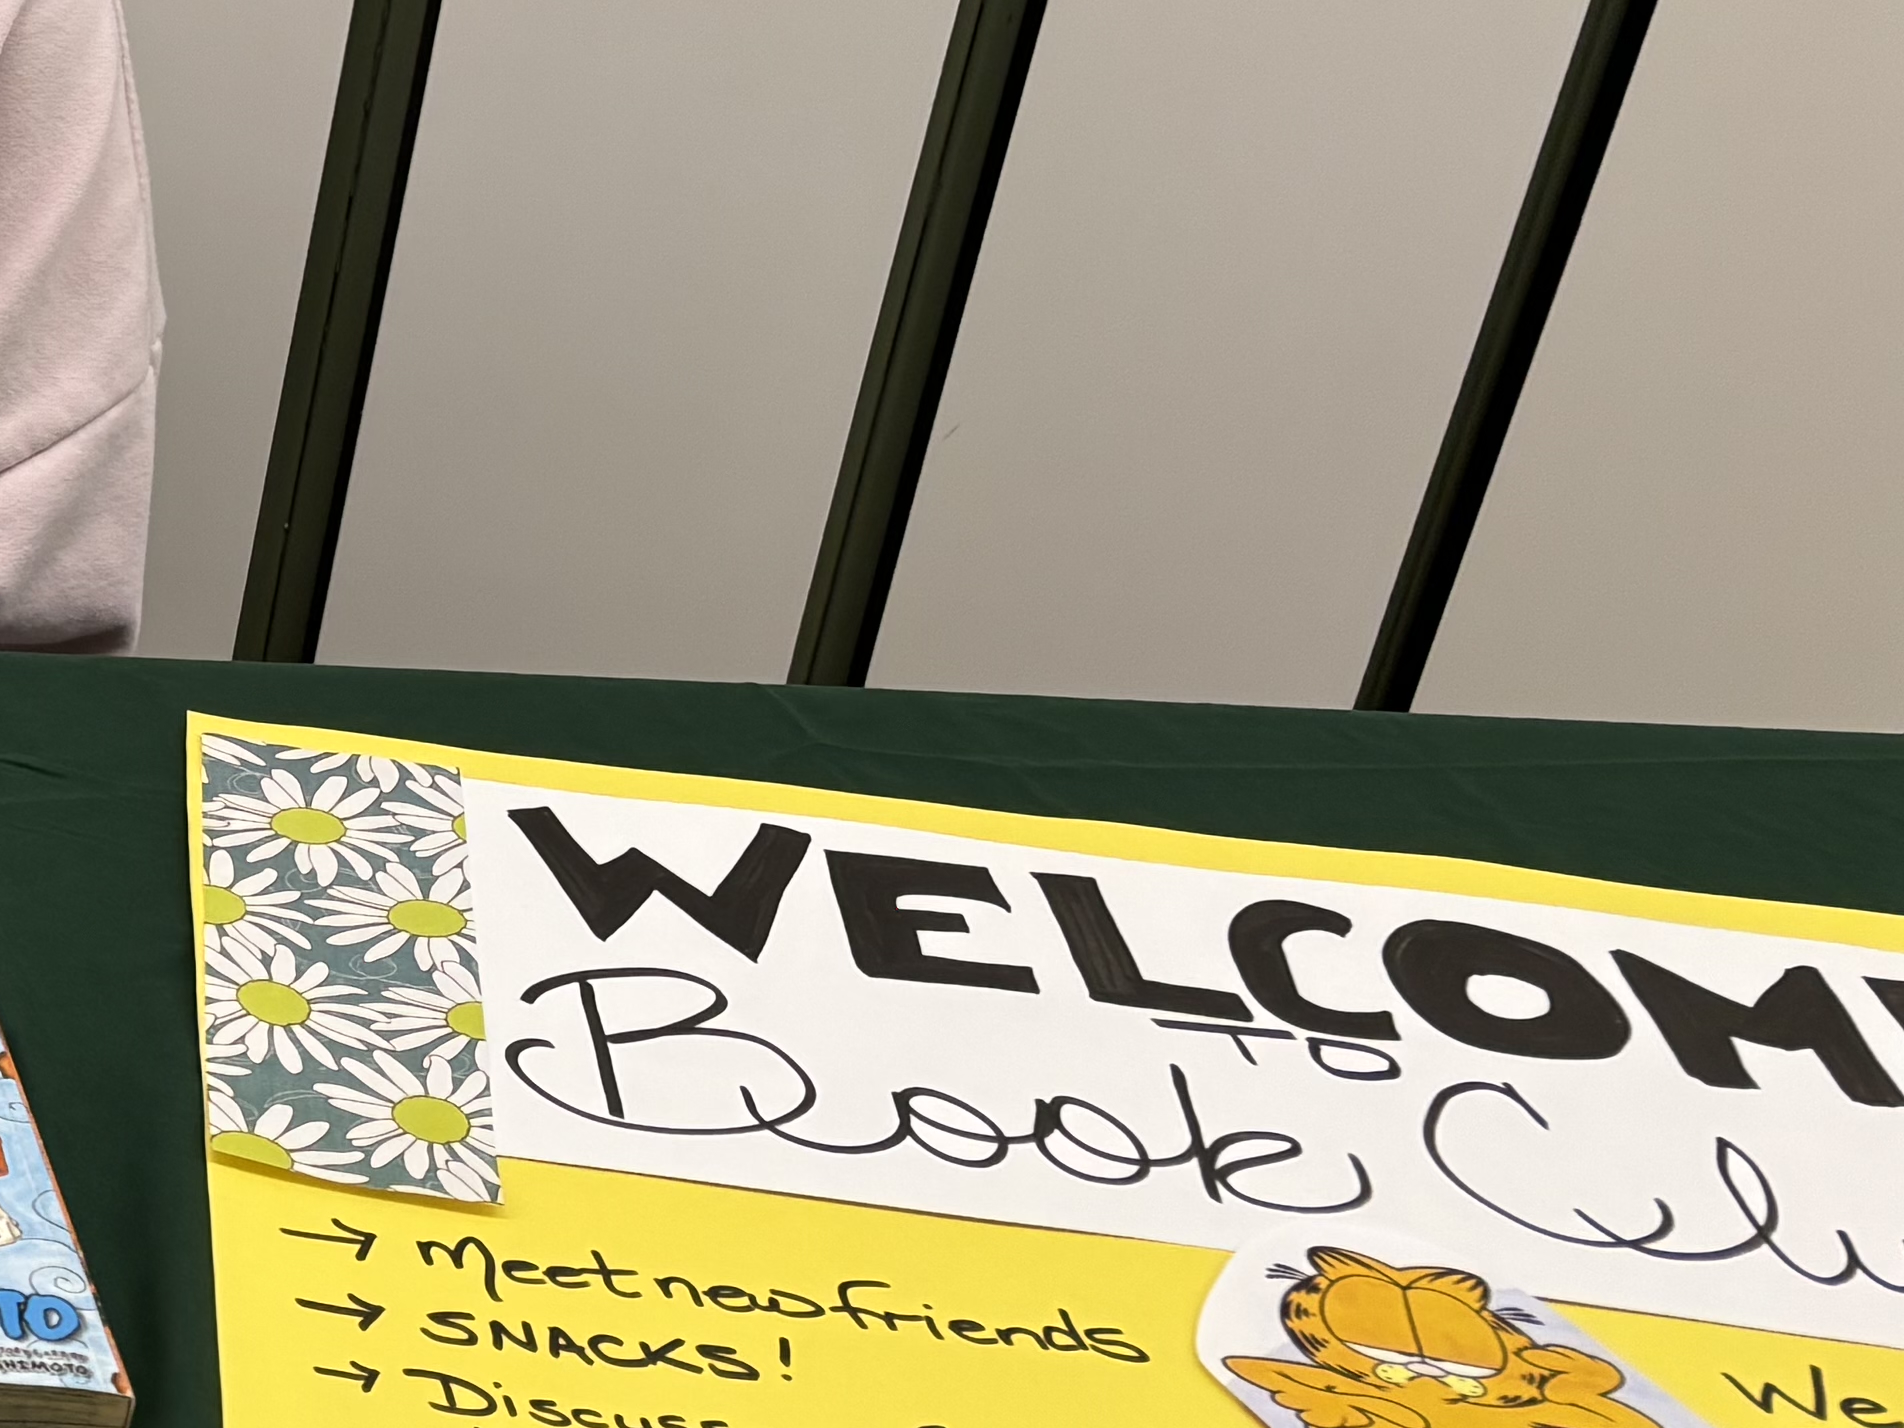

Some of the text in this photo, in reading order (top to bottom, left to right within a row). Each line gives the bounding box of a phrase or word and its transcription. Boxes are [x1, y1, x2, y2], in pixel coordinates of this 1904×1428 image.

[504, 803, 1904, 1107] WELCOM
[505, 967, 1373, 1215] Book
[1151, 1017, 1402, 1083] TO
[414, 1234, 1152, 1364] Meet new friends
[418, 1310, 796, 1381] SNACKS!
